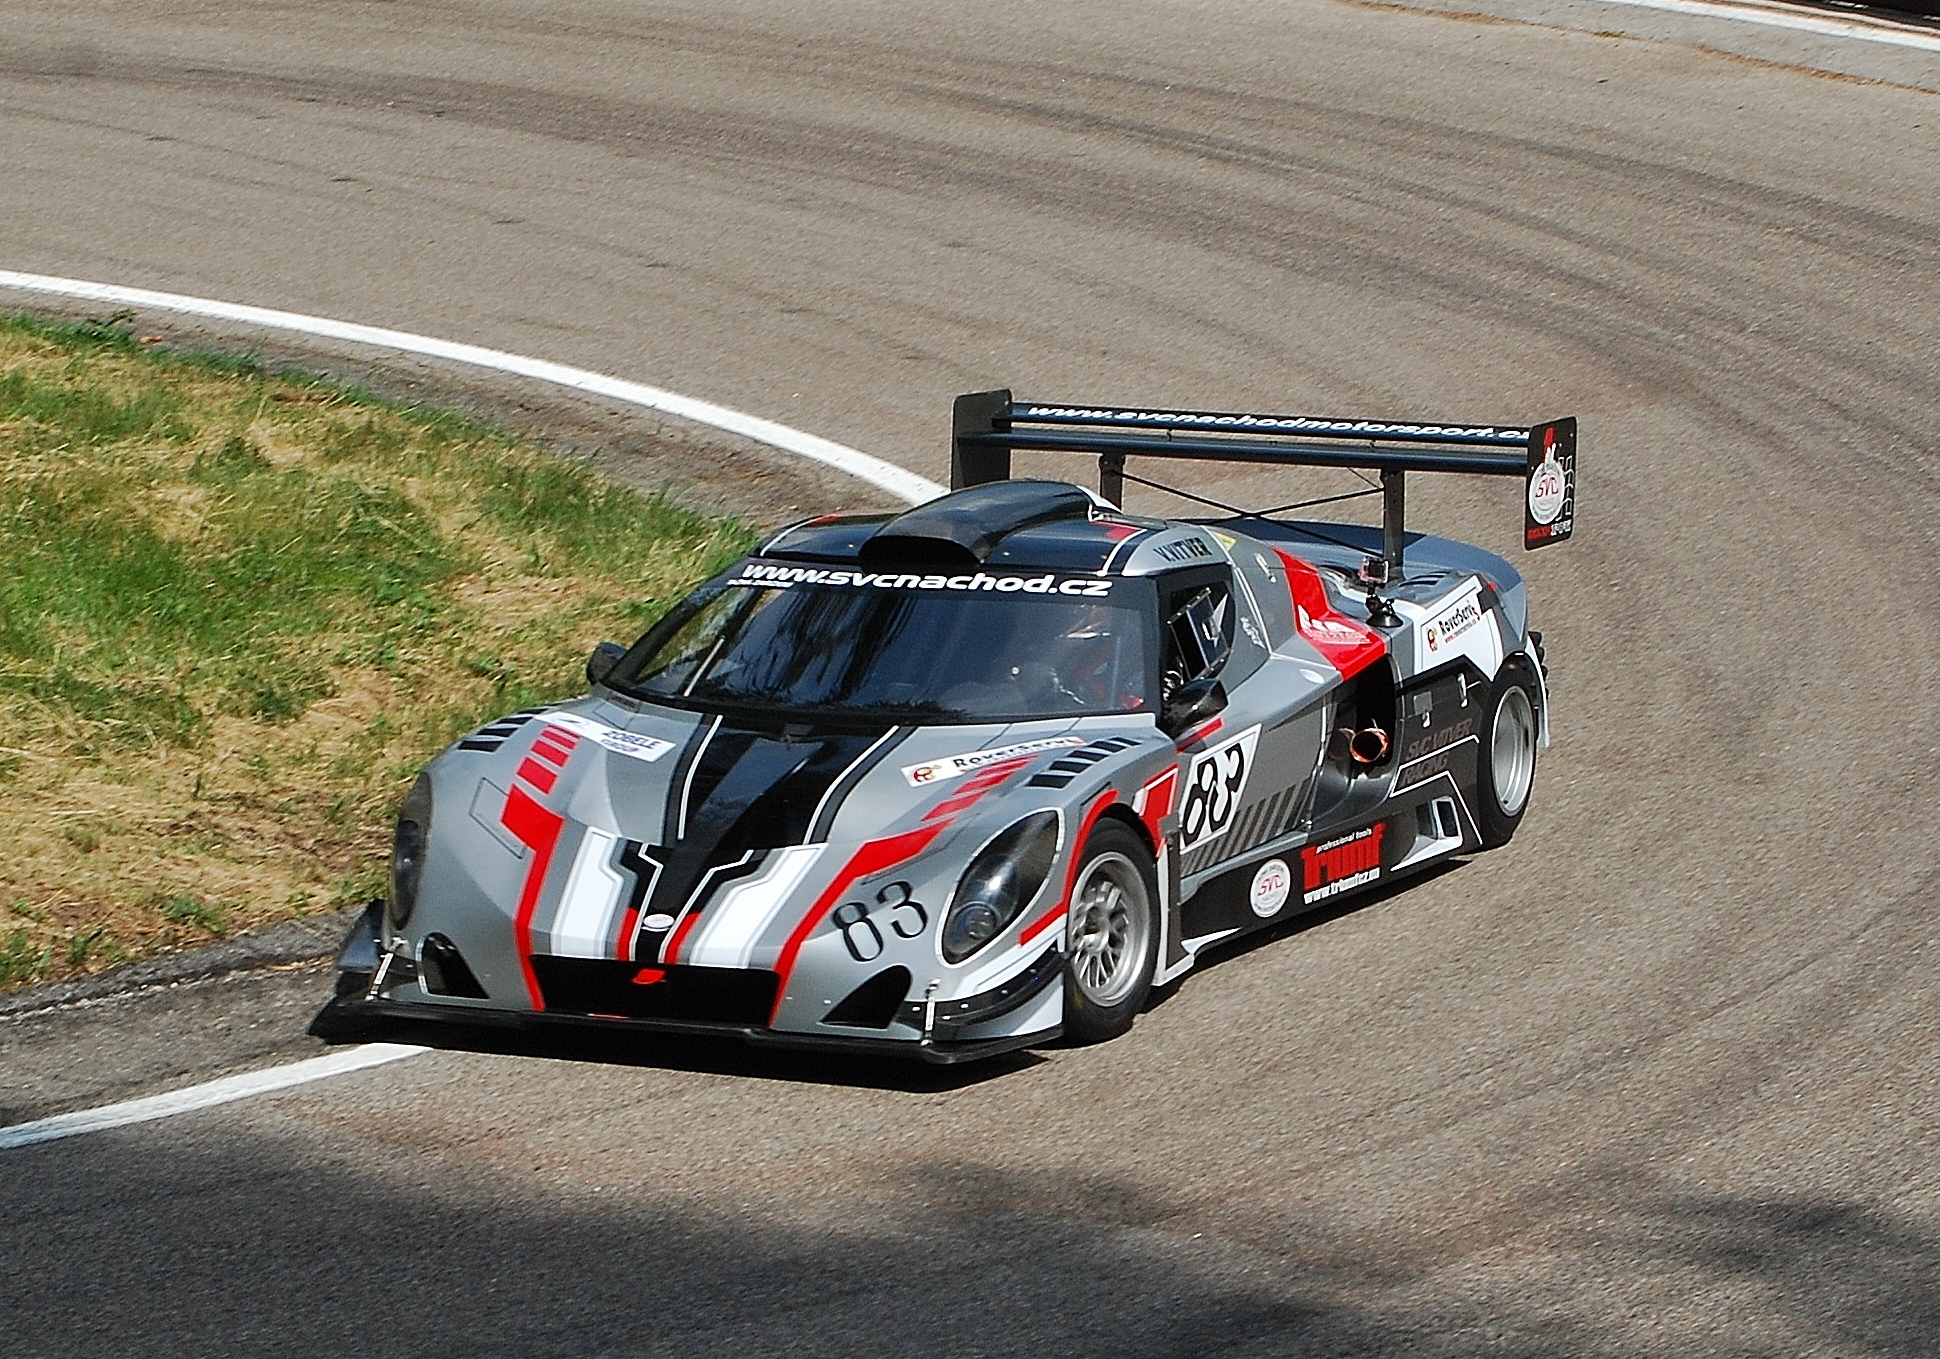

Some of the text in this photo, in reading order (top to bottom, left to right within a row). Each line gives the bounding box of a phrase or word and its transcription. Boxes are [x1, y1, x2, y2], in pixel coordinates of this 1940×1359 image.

[1535, 477, 1559, 498] SVC
[742, 564, 1112, 597] www.svcnachod.cz
[1183, 743, 1245, 847] 83
[1258, 875, 1284, 896] SVC
[831, 881, 928, 962] 83
